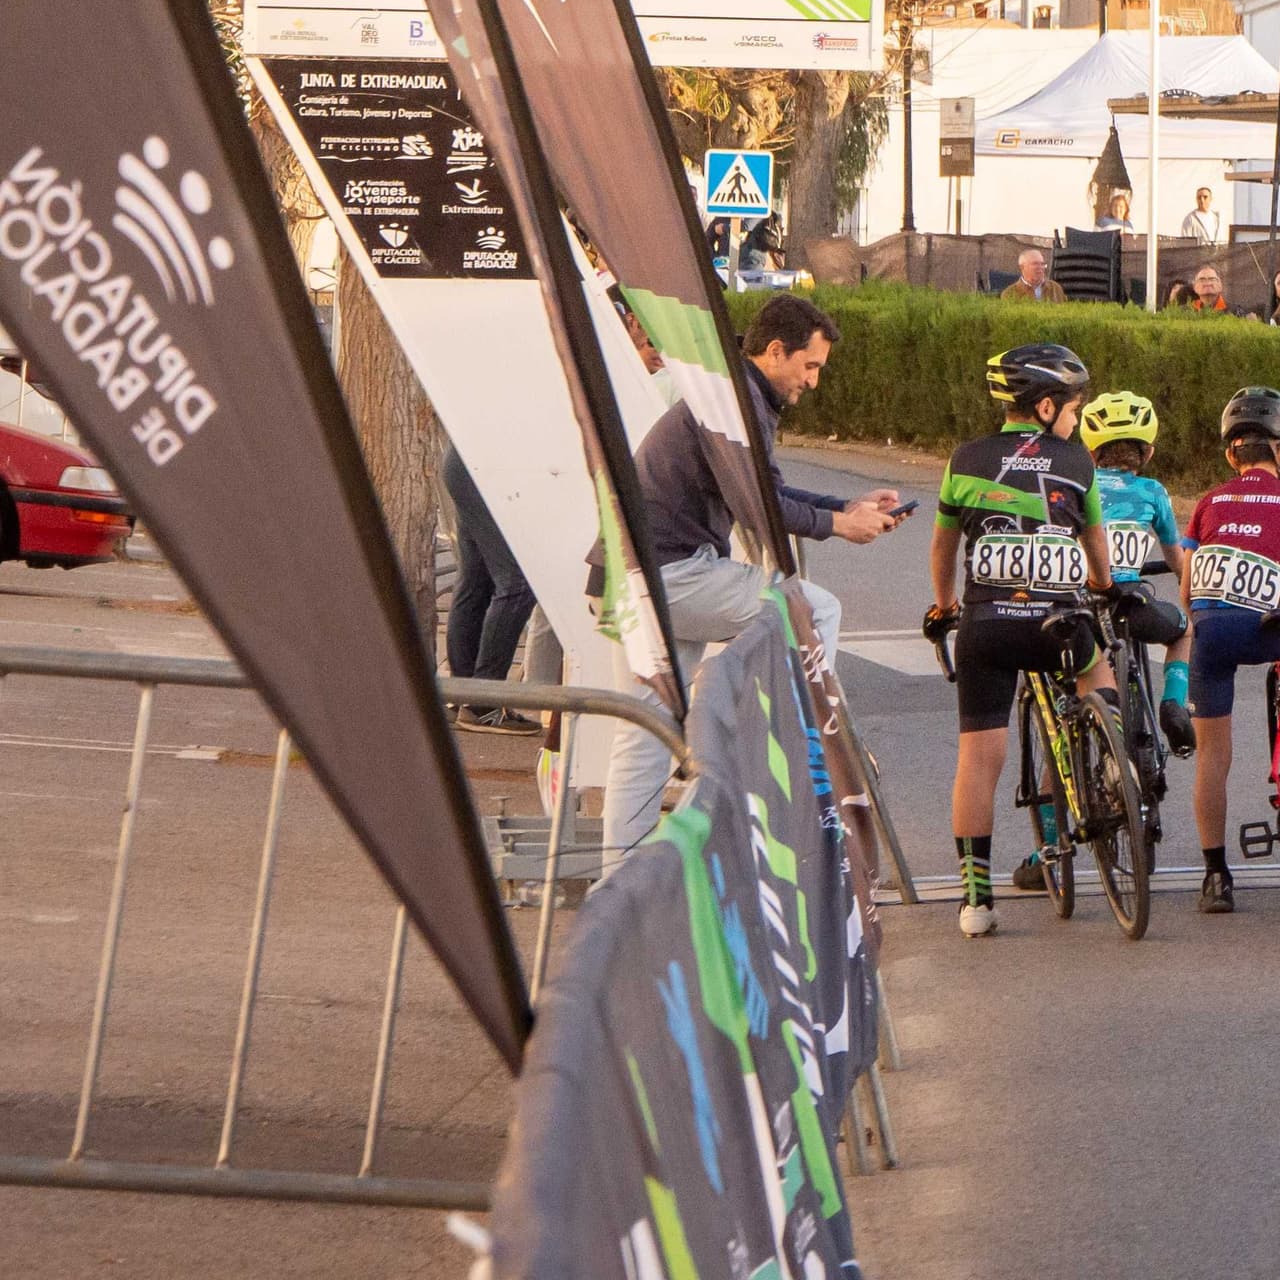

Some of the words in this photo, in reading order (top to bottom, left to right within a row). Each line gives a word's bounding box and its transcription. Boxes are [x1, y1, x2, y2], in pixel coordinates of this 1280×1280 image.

[409, 38, 436, 47] travel
[299, 73, 335, 90] JUNTA
[341, 73, 357, 88] DE
[360, 74, 447, 90] EXTREMADURA
[299, 94, 338, 107] Consejería
[339, 94, 349, 106] de
[398, 108, 433, 120] Deportes
[1024, 138, 1074, 146] CAMACHO
[341, 144, 400, 152] CICLISMO
[374, 207, 420, 216] EXTREMADURA
[441, 204, 504, 215] Extremadura
[371, 247, 421, 257] DIPUTACIÓN
[463, 250, 518, 261] DIPUTACIÓN
[371, 256, 383, 264] DE
[474, 260, 517, 270] BADAJOZ
[1111, 531, 1150, 567] 801
[977, 543, 1025, 579] 818
[1038, 544, 1083, 583] 818
[1190, 553, 1232, 589] 805
[1231, 559, 1279, 603] 805
[997, 607, 1006, 615] LA
[1006, 608, 1032, 617] PISCINA
